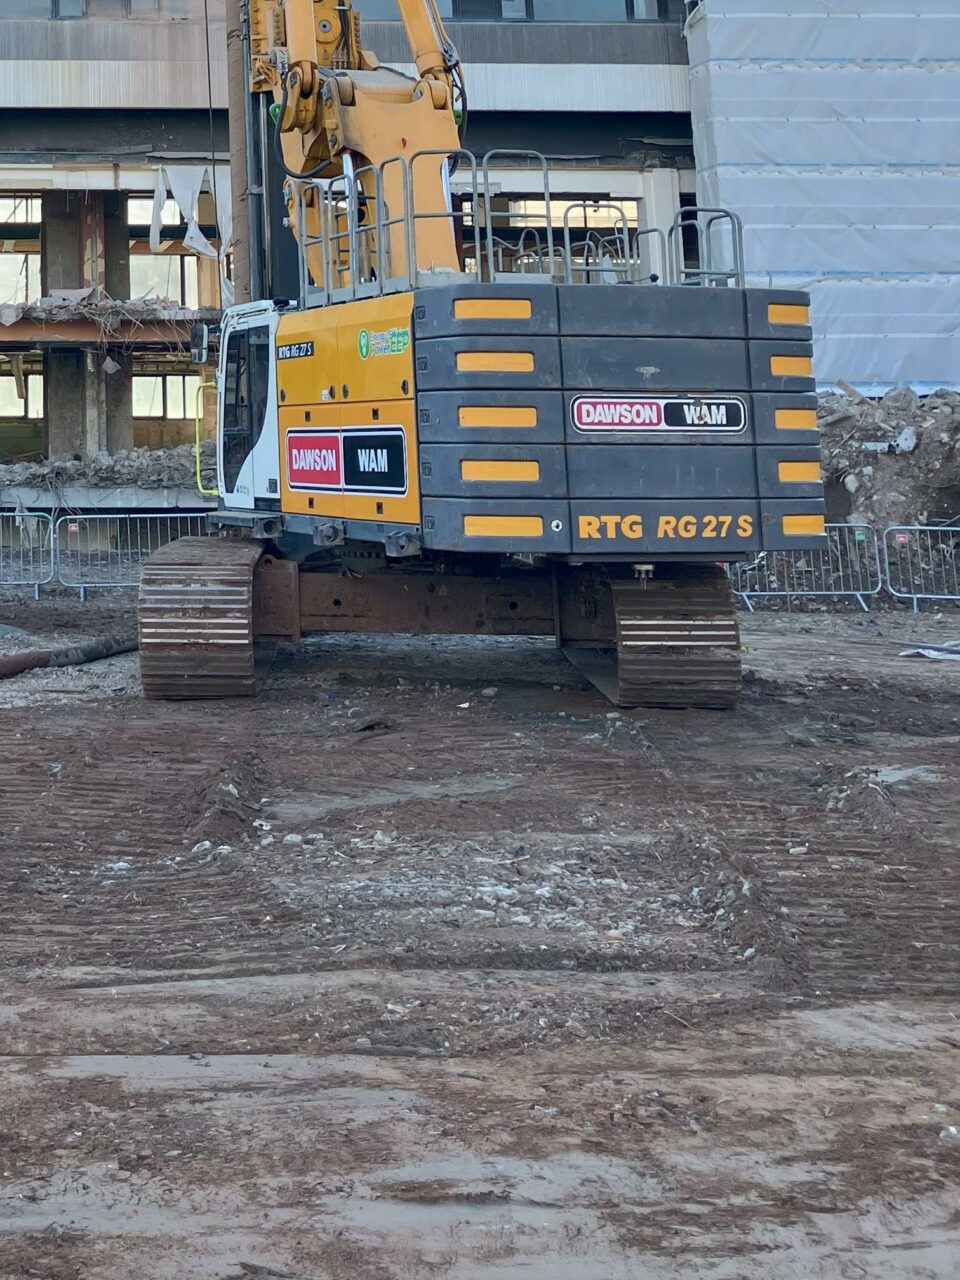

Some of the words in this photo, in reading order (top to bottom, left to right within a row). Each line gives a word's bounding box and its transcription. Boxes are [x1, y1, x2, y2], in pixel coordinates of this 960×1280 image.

[300, 343, 307, 356] 27
[307, 342, 312, 355] S
[581, 403, 658, 424] DAWSON
[683, 404, 727, 425] WAM
[291, 448, 337, 472] DAWSON
[357, 448, 389, 473] WAM
[578, 514, 643, 539] RTG
[656, 515, 697, 538] RG
[701, 515, 732, 538] 27
[736, 514, 753, 538] S
